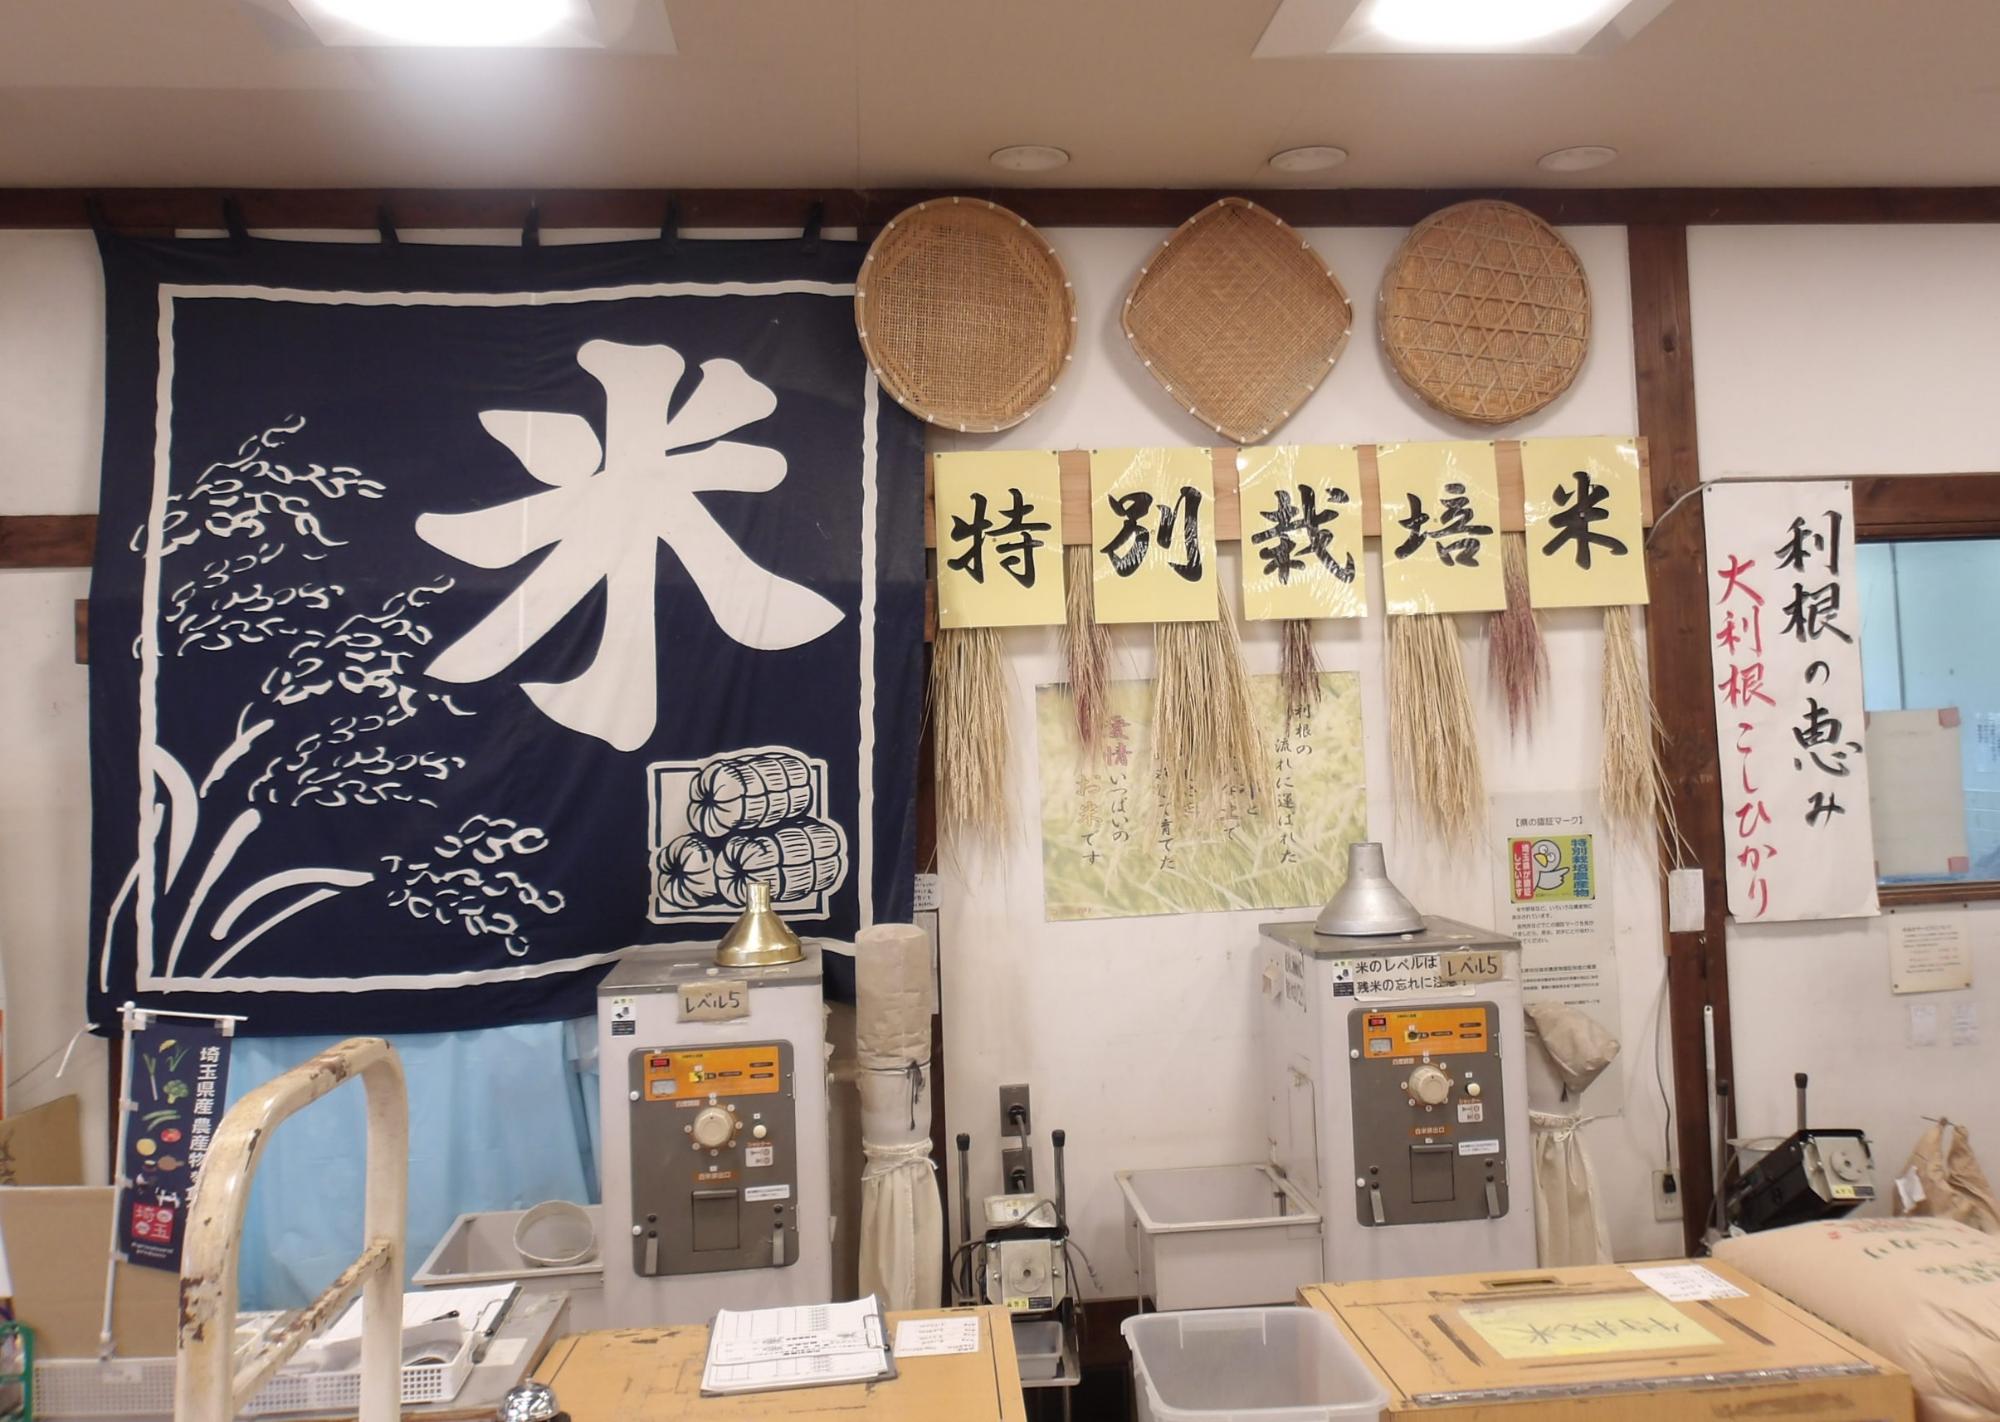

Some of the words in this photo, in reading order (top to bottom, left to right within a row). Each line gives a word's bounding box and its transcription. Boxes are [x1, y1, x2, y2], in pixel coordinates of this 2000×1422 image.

[415, 339, 846, 752] 米
[947, 469, 1629, 590] 特別栽培米
[1774, 510, 1863, 830] 利根の恵み
[1716, 554, 1778, 920] 大利根こしひかり
[1513, 855, 1524, 897] しています
[686, 991, 741, 1014] レベル5
[1355, 956, 1438, 975] 米のレベルは
[1447, 955, 1498, 977] レベル5
